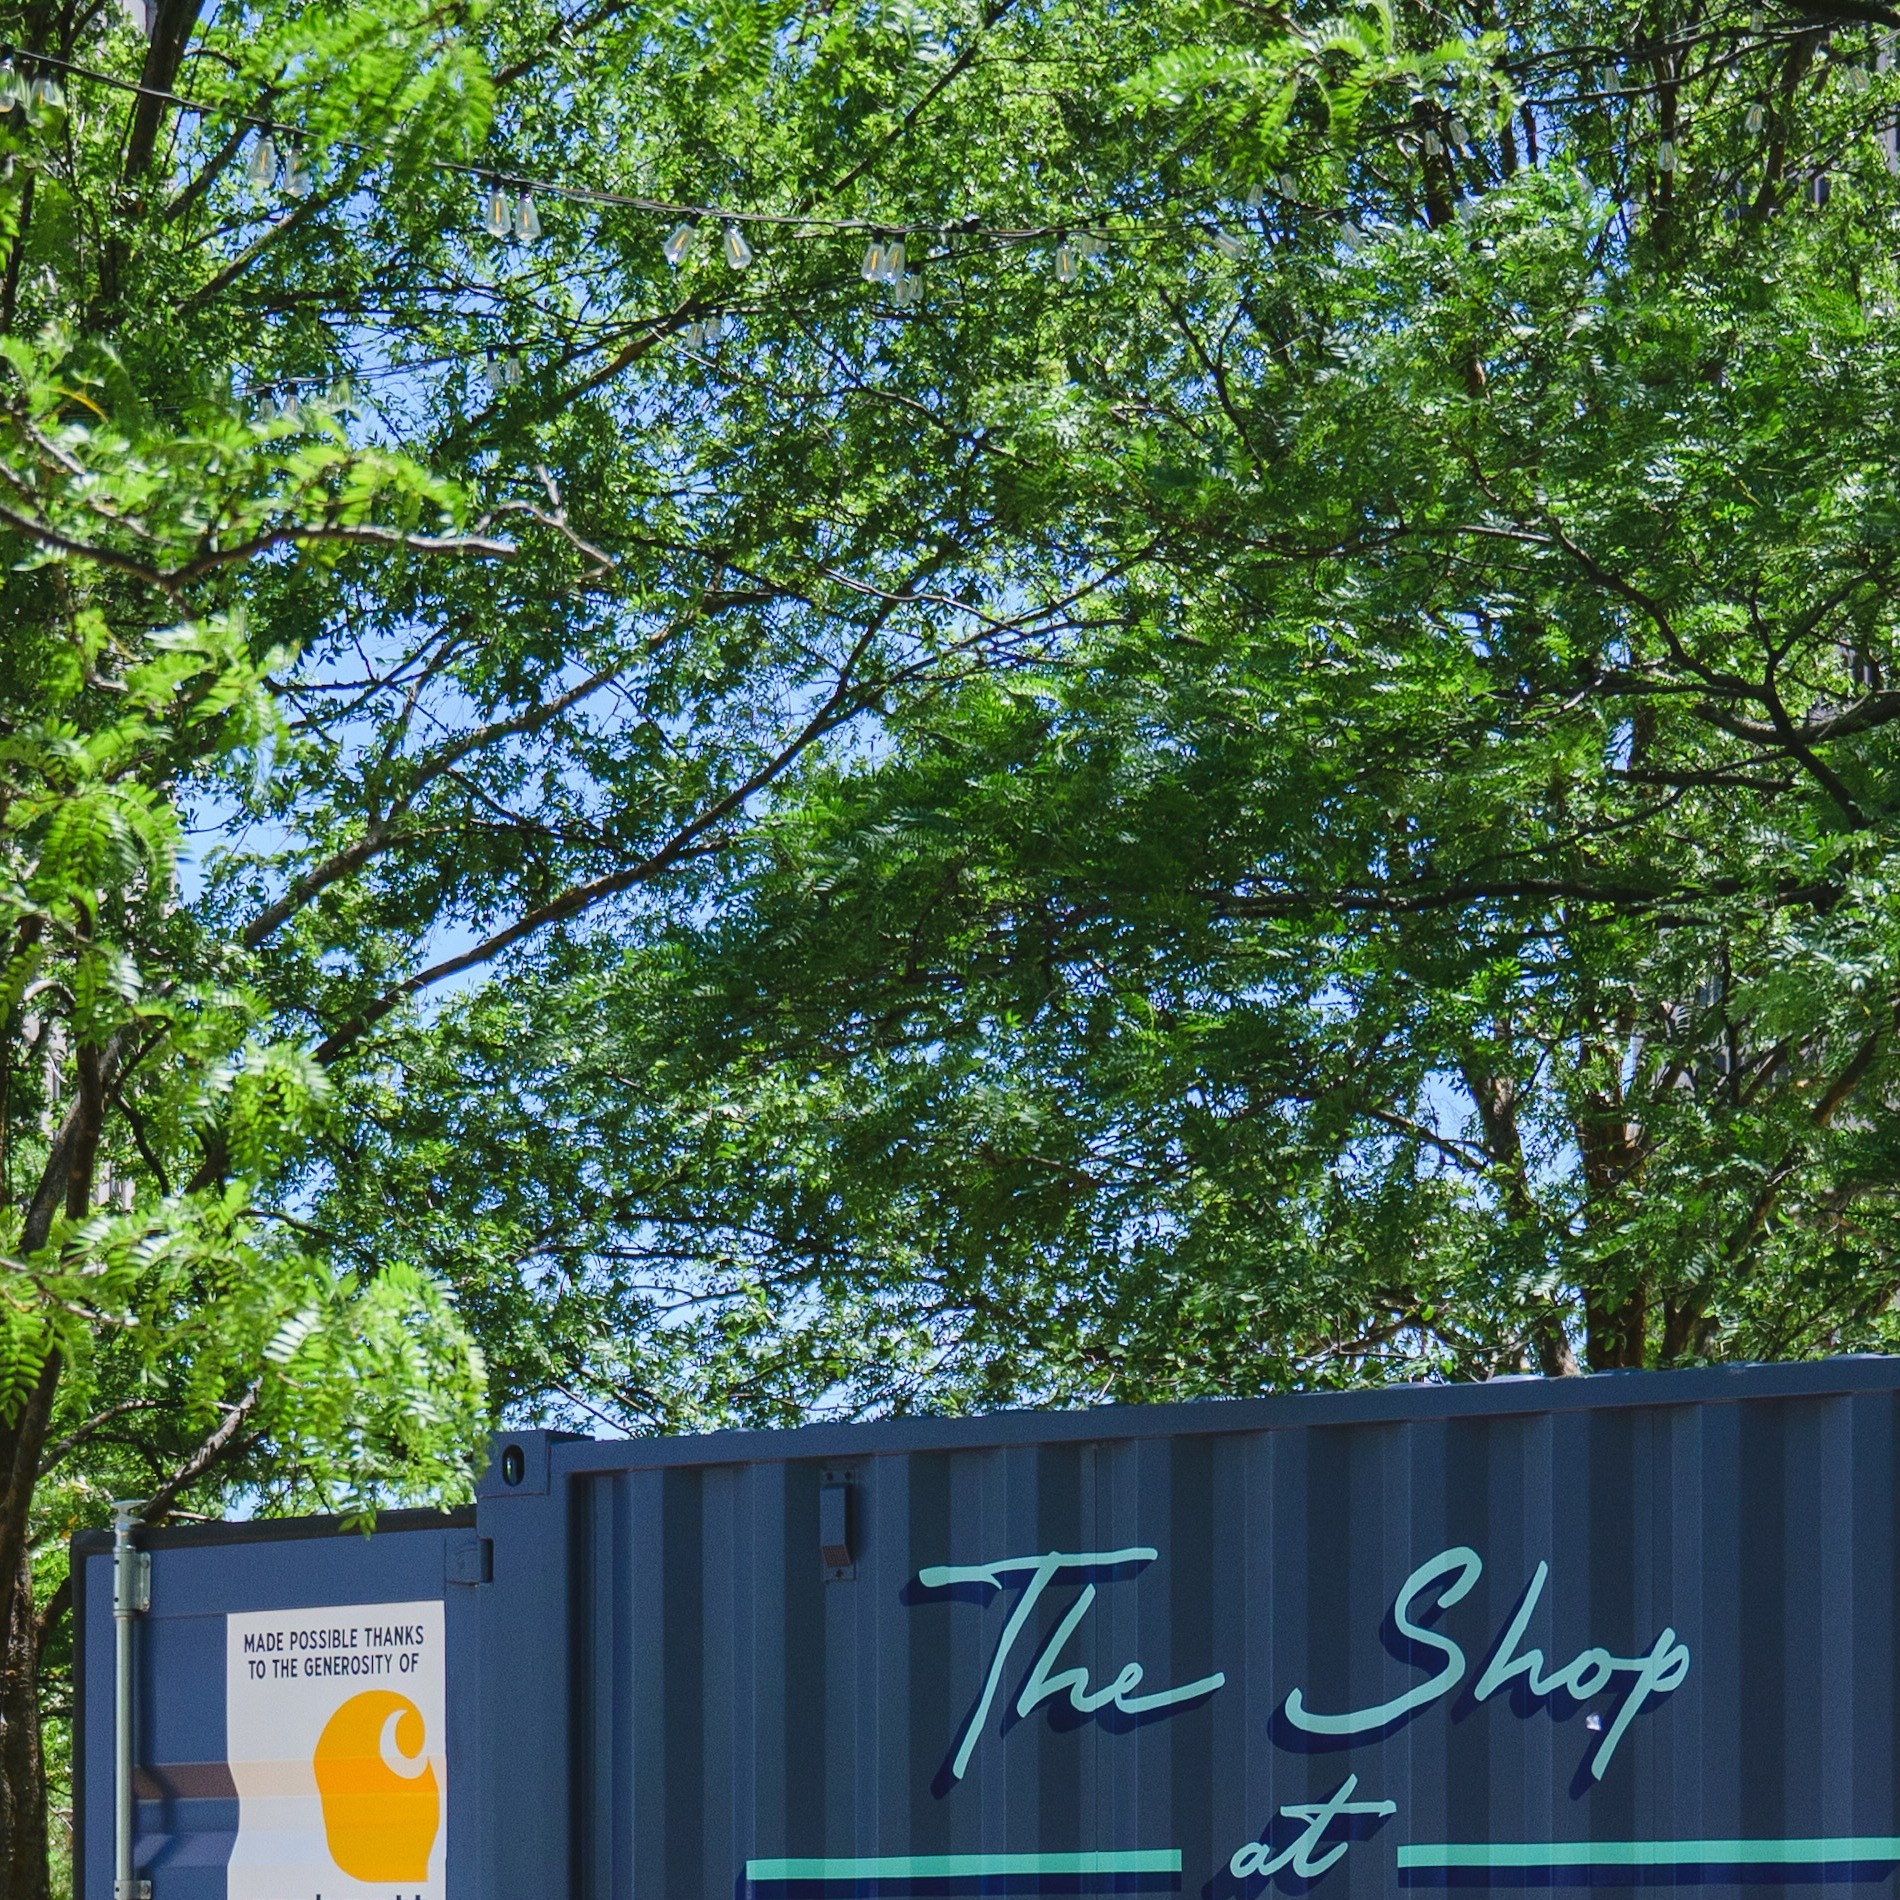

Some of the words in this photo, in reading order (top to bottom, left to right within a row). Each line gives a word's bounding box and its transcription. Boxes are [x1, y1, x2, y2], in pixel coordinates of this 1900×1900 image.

[244, 1632, 284, 1653] MADE
[289, 1628, 358, 1651] POSSIBLE
[364, 1625, 424, 1648] THANKS
[248, 1659, 266, 1680] TO
[272, 1657, 298, 1679] THE
[304, 1653, 393, 1677] GENEROSITY
[399, 1652, 420, 1674] OF
[918, 1546, 1226, 1780] The
[1284, 1546, 1690, 1780] Shop
[1229, 1773, 1398, 1879] at
